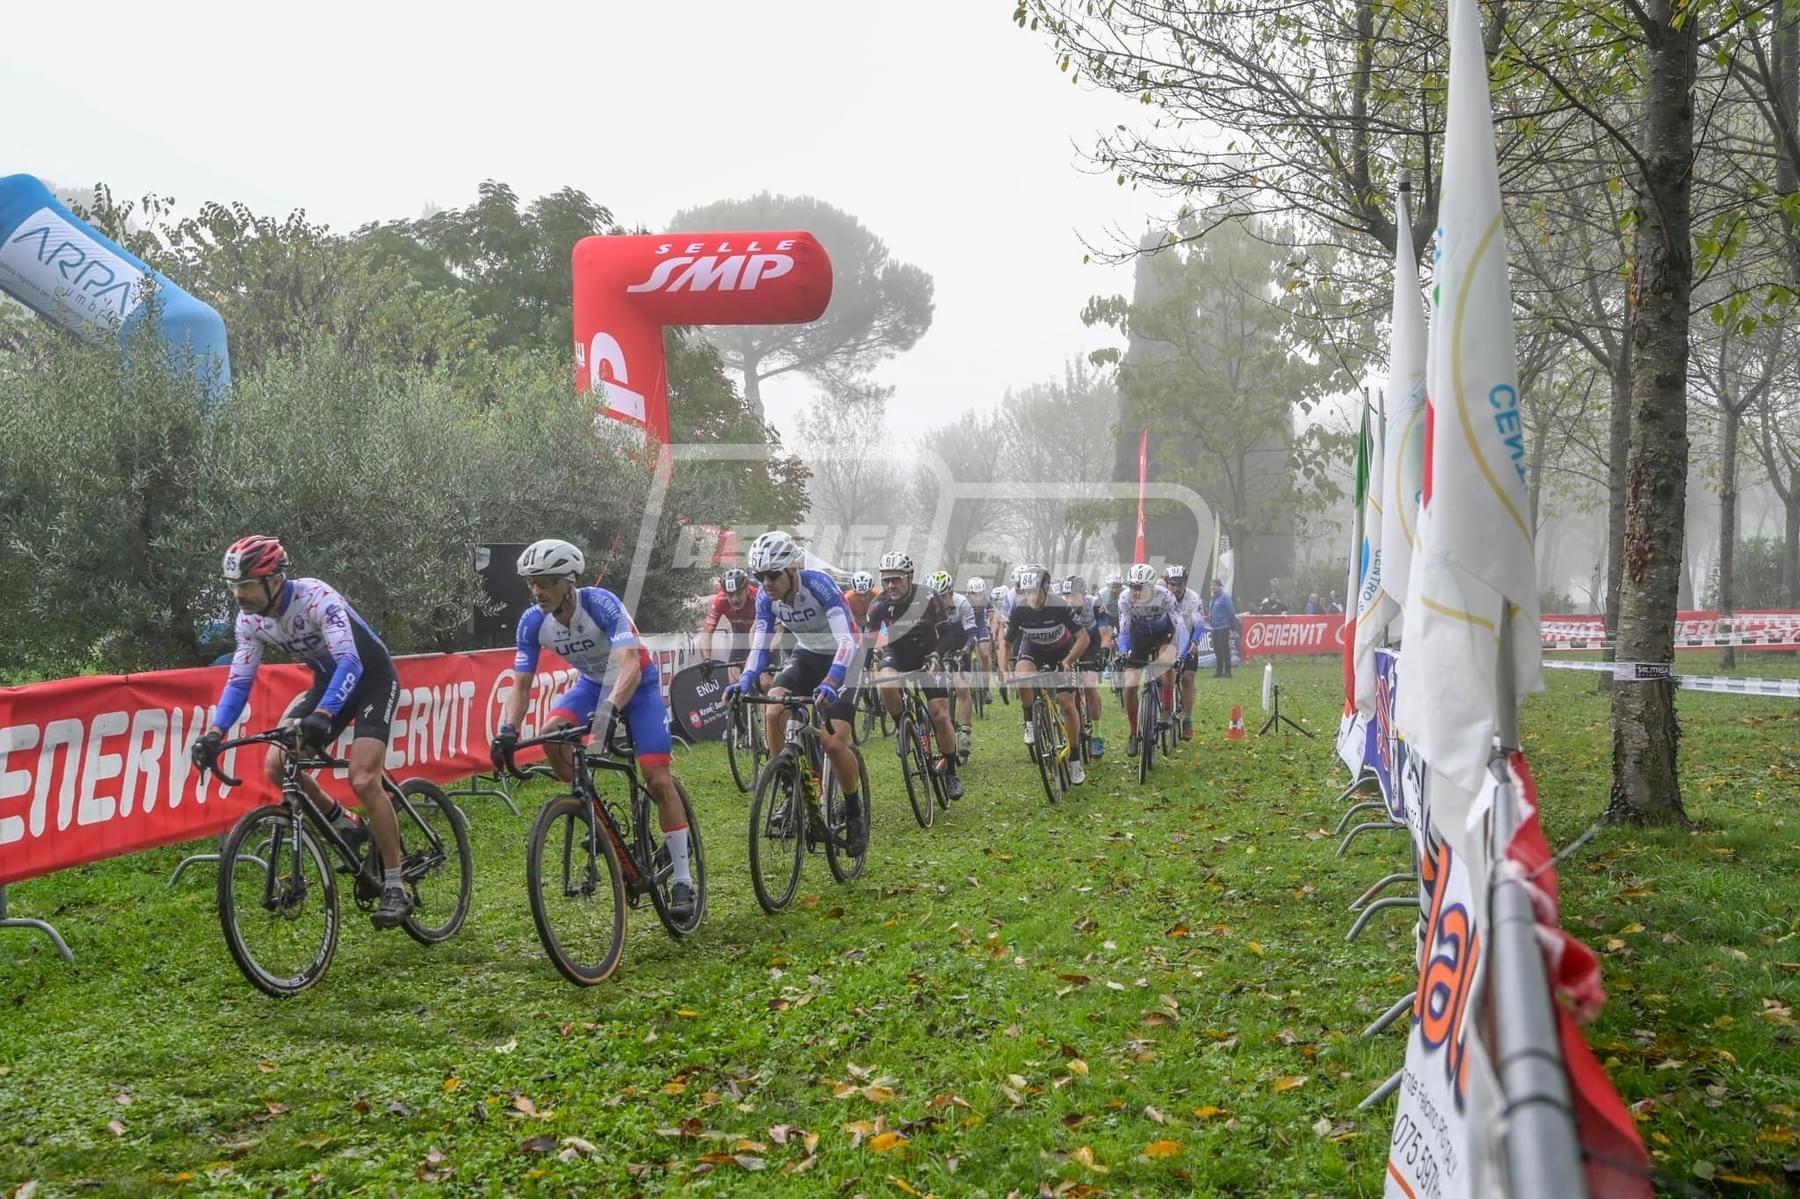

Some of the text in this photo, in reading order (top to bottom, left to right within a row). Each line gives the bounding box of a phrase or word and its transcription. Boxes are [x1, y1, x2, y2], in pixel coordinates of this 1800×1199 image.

[655, 239, 796, 255] SELLE
[12, 226, 131, 315] ARPA
[626, 254, 795, 293] SMP
[225, 556, 237, 571] 85
[751, 552, 764, 568] 67
[885, 557, 896, 568] 91
[1022, 573, 1033, 585] 84
[780, 608, 816, 623] UCP
[1264, 622, 1328, 647] ENERVIT
[555, 639, 595, 656] UCP
[336, 673, 357, 703] UCP
[696, 679, 720, 697] ENDU
[1393, 1112, 1423, 1166] 075
